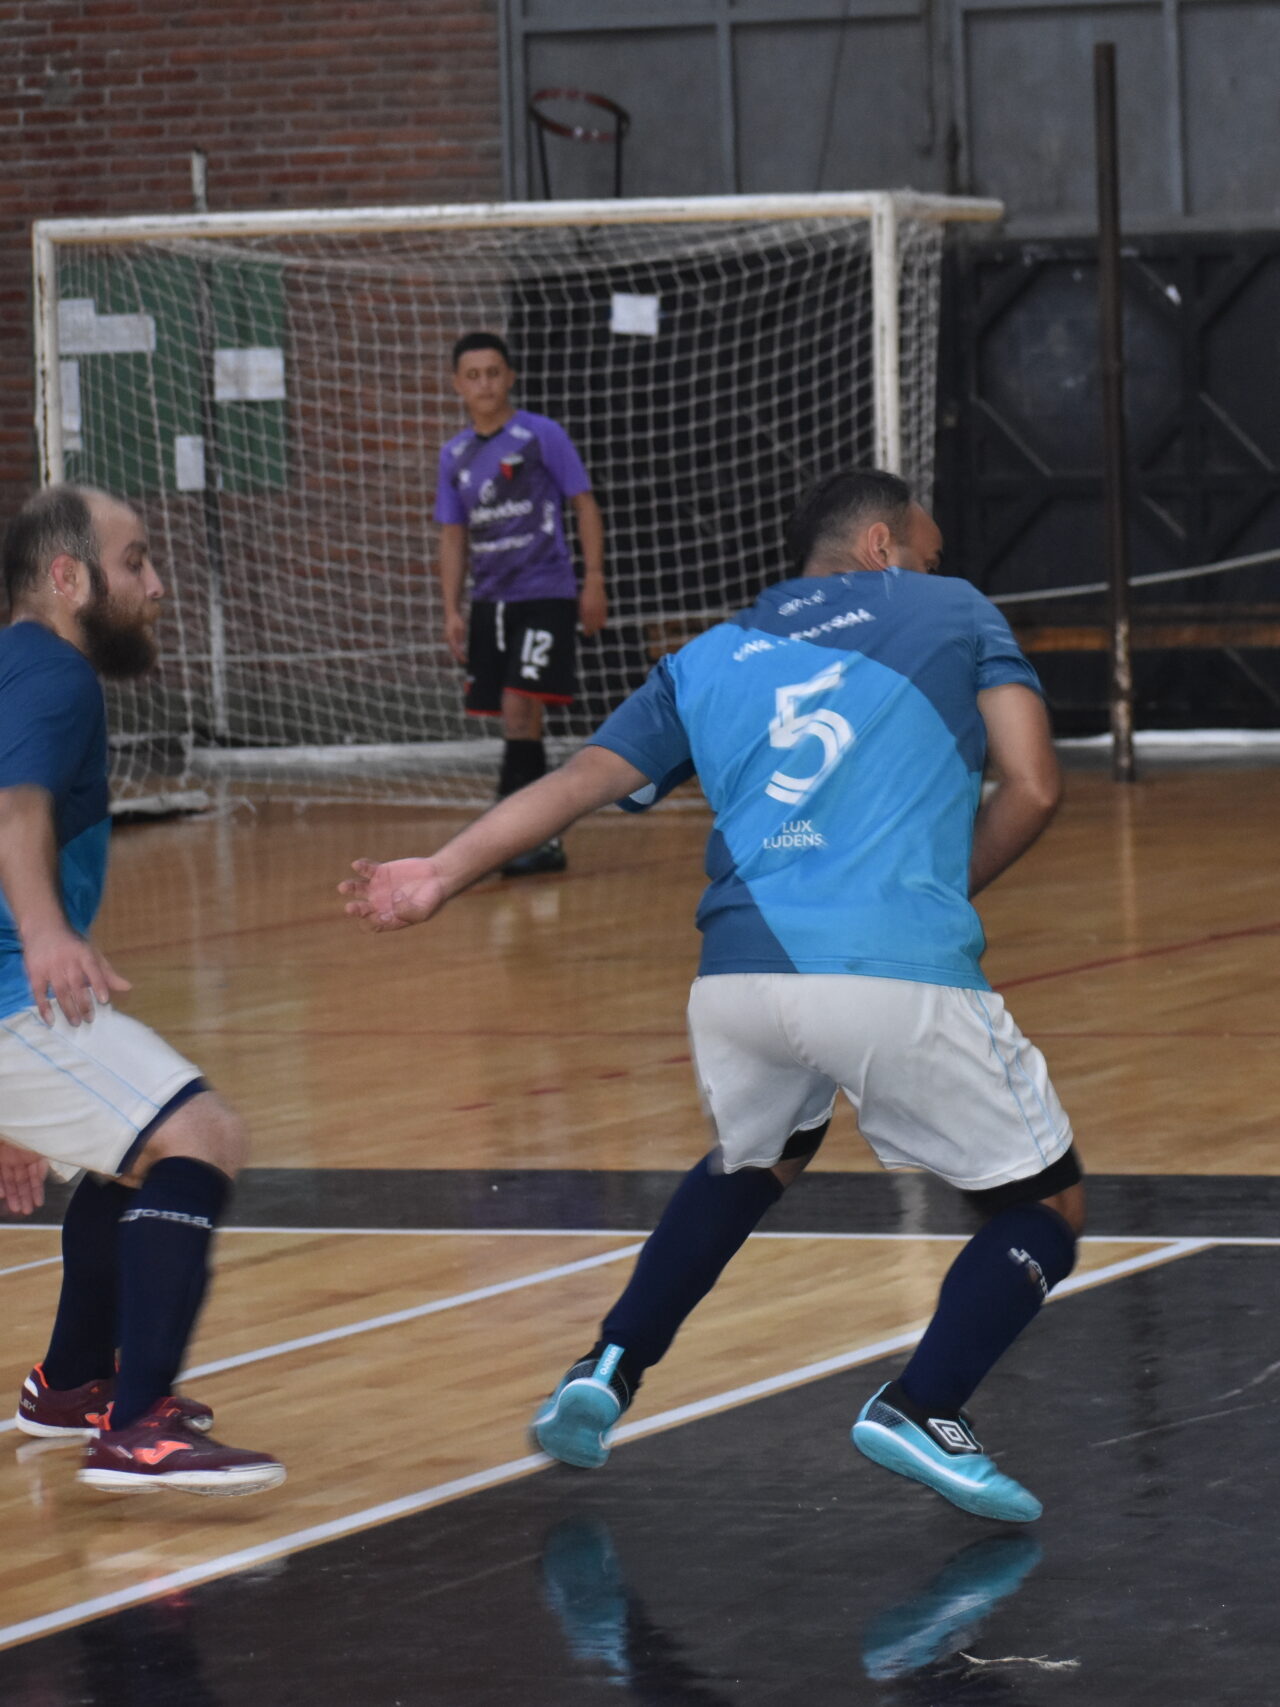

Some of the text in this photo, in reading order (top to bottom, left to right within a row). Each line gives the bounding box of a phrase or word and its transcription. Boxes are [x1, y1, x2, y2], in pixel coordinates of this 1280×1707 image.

[521, 628, 554, 667] 12
[765, 661, 854, 805] 5
[782, 819, 814, 834] LUX
[763, 833, 826, 850] LUDENS
